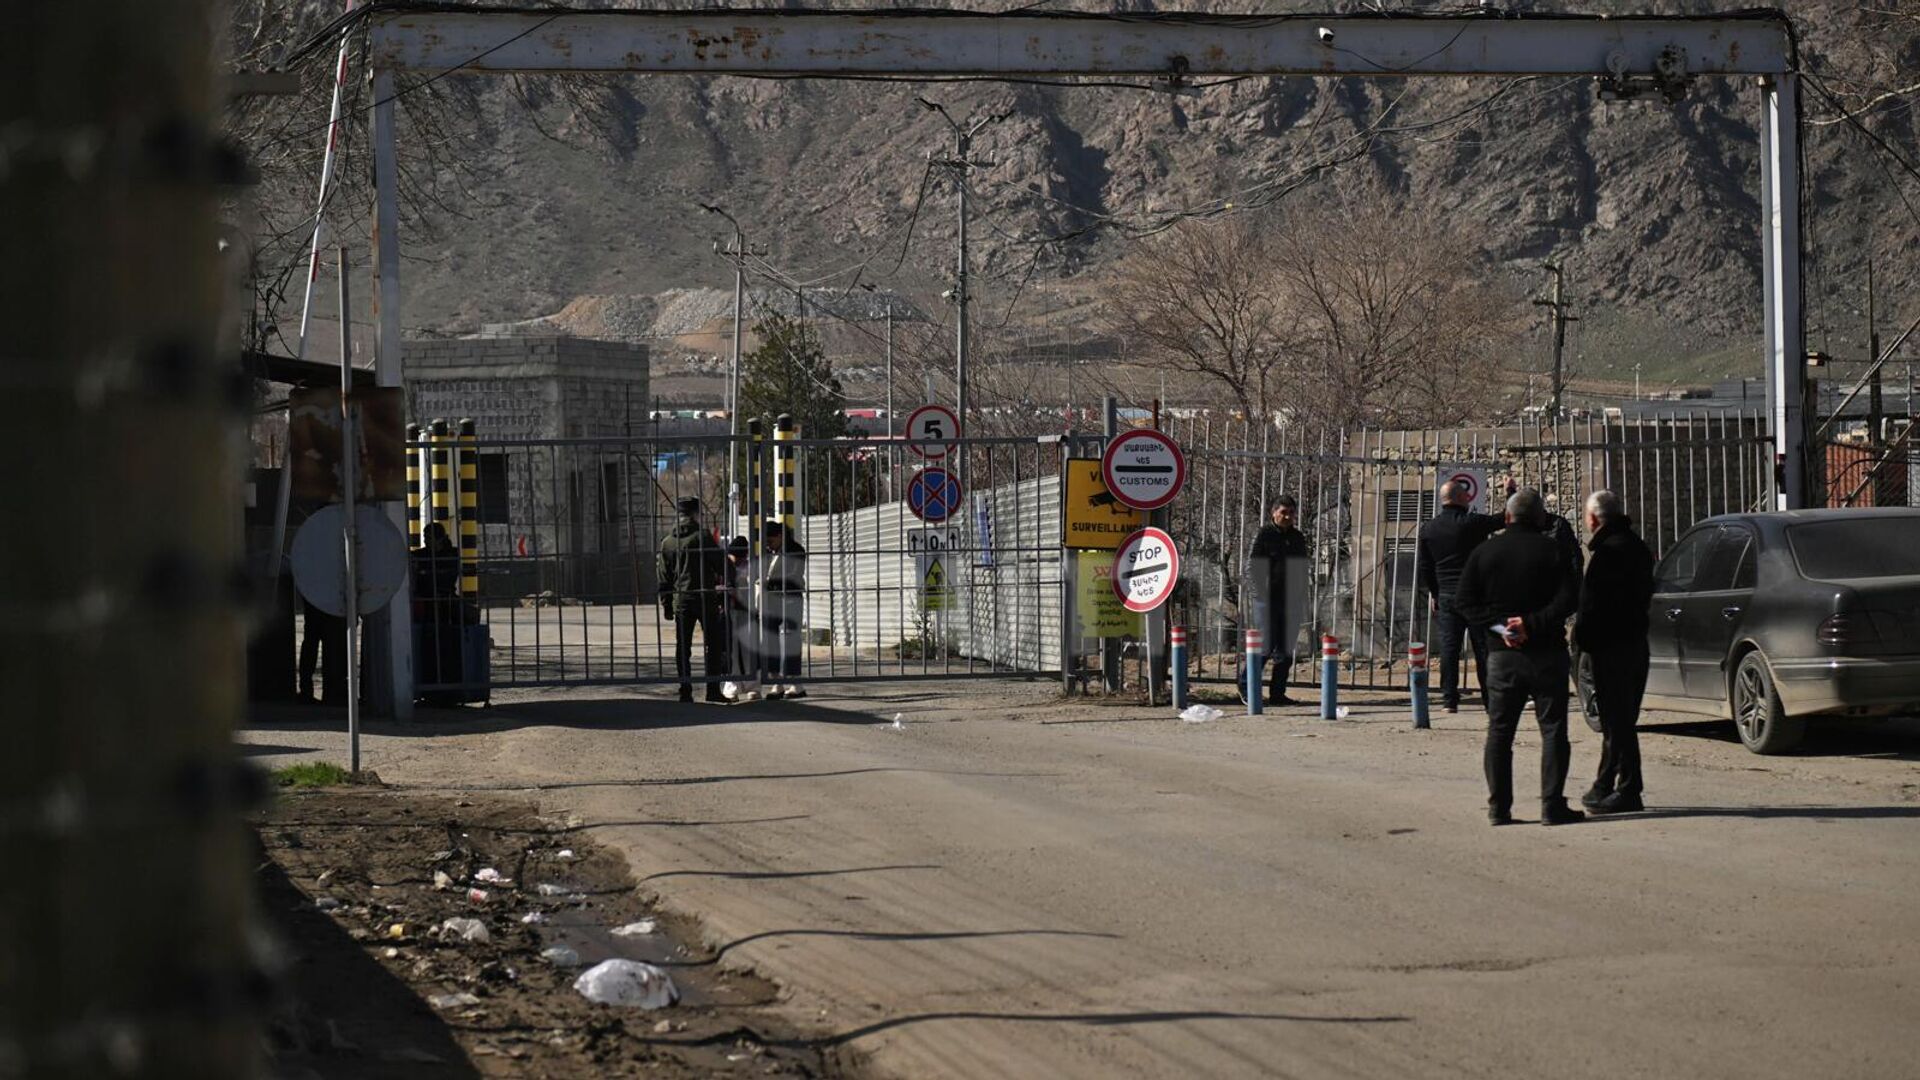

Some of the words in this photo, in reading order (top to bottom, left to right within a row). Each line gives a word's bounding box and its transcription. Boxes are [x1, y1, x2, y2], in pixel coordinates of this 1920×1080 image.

[924, 420, 943, 441] 5
[1120, 477, 1169, 486] CUSTOMS
[1129, 546, 1162, 563] STOP
[1138, 588, 1154, 597] ԿԵՏ
